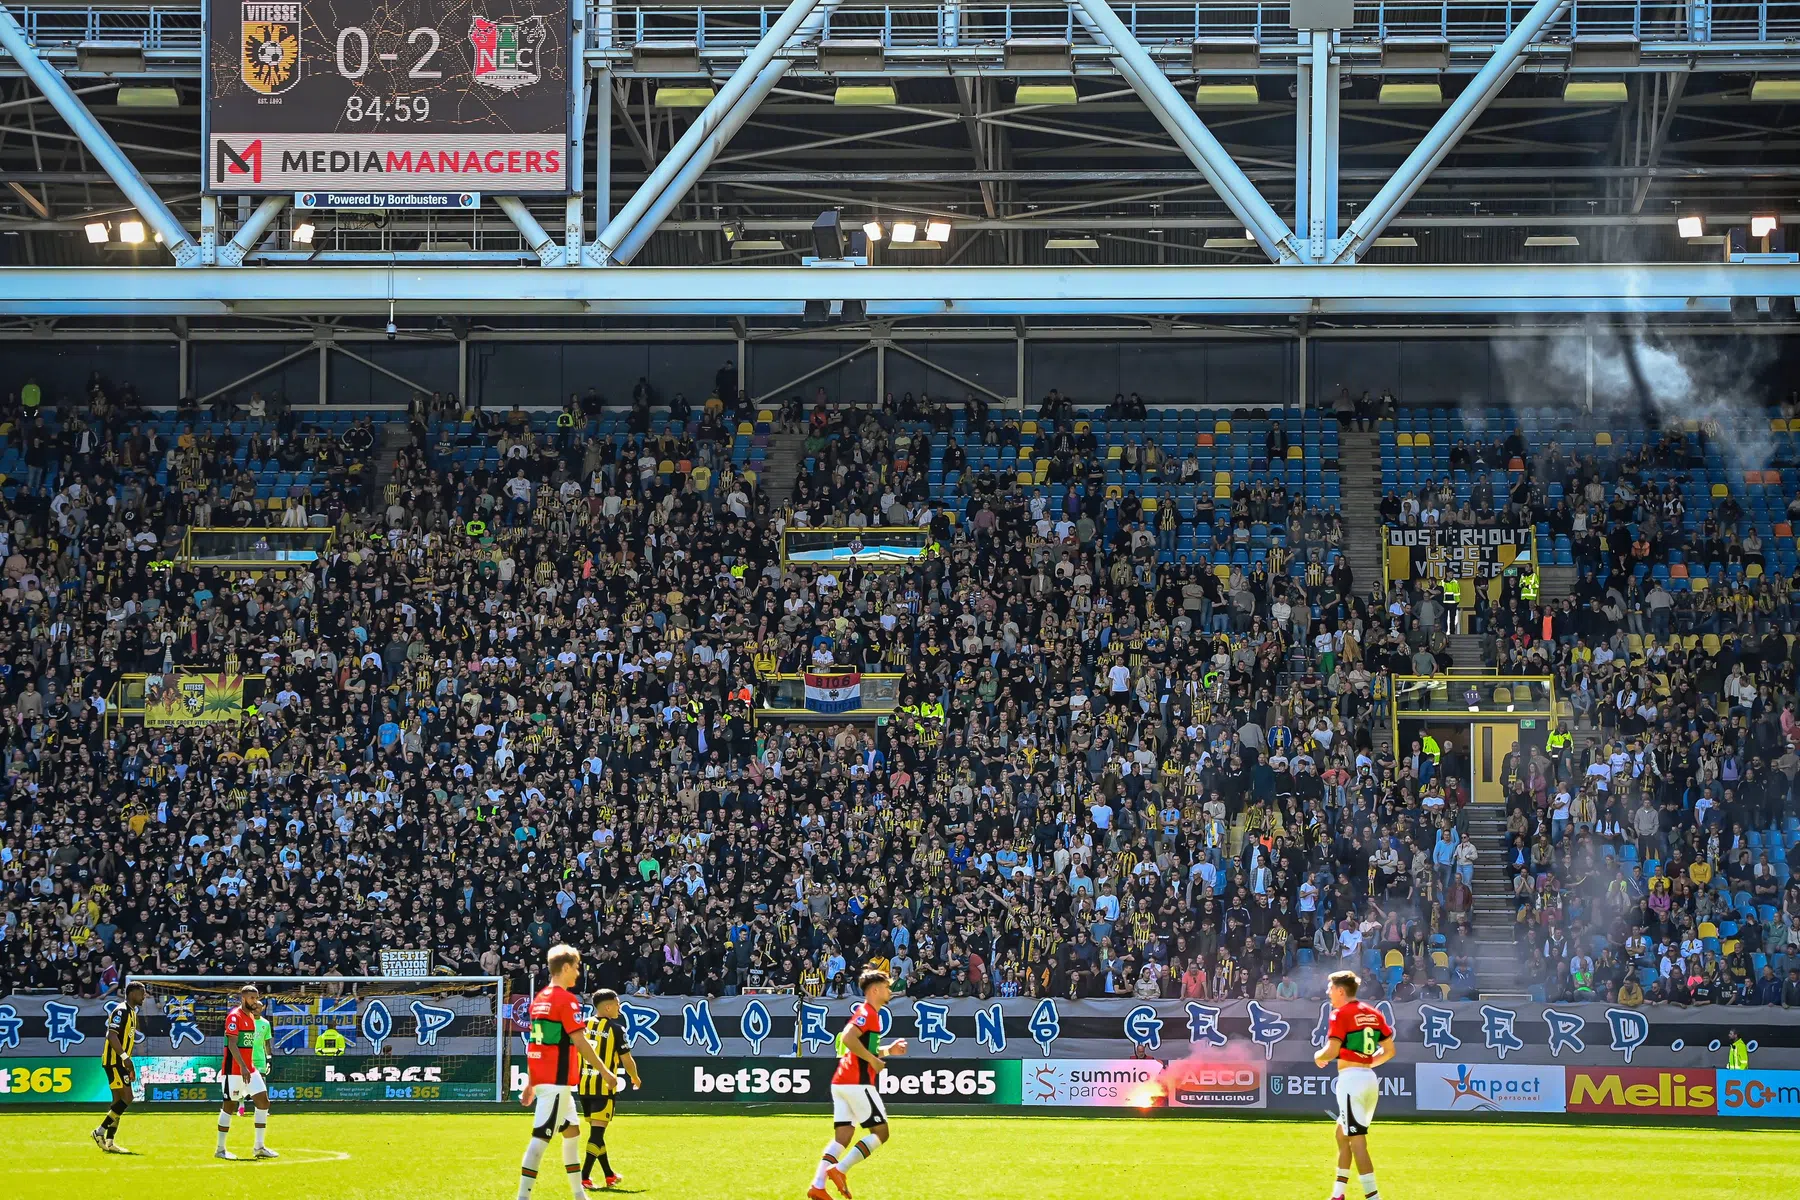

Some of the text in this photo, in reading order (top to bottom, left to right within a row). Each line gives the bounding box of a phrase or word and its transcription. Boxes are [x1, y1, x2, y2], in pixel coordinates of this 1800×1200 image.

[246, 5, 297, 21] VITESSE
[480, 48, 533, 67] NEC
[346, 96, 430, 122] 84:59
[281, 150, 560, 173] MEDIAMANAGERS
[328, 194, 448, 207] Powered by Bordbusters
[381, 951, 428, 960] SECTIE
[382, 961, 427, 969] STADION
[382, 969, 427, 977] VERBOD
[530, 1023, 544, 1045] 4
[1363, 1027, 1376, 1056] 6
[694, 1067, 811, 1094] bet365
[878, 1068, 997, 1095] bet365
[1181, 1070, 1254, 1086] ABCO
[153, 1087, 207, 1100] bet365
[268, 1086, 323, 1099] bet365
[385, 1085, 440, 1099] bet365
[1070, 1086, 1118, 1099] parcs
[1569, 1073, 1715, 1107] Melis
